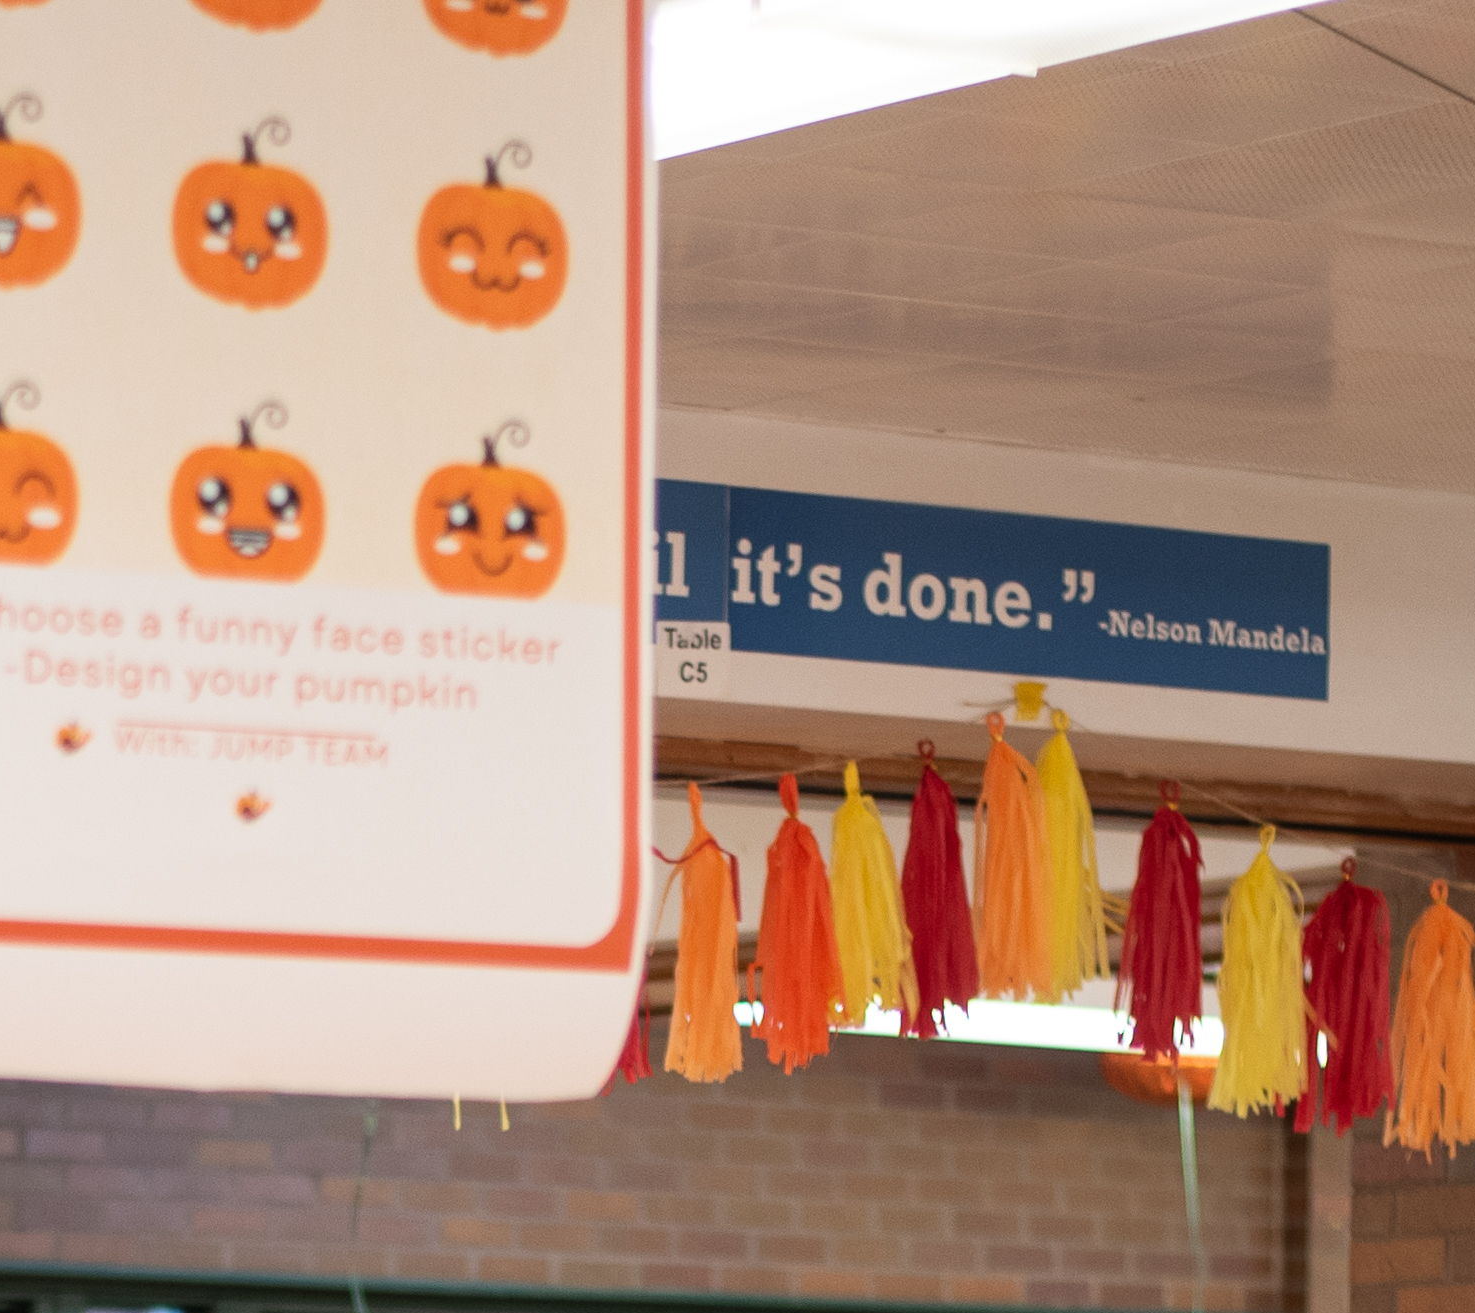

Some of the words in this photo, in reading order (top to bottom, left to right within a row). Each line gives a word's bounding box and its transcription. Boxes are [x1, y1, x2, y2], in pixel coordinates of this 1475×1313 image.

[731, 537, 843, 612] it’s
[862, 551, 1096, 631] done.”
[139, 612, 161, 640] a
[177, 604, 298, 657] funny
[313, 613, 404, 656] face
[418, 624, 561, 665] sticker
[1098, 609, 1202, 645] -Nelson
[1207, 618, 1327, 655] Mandela
[4, 648, 170, 699] -Design
[186, 667, 278, 703] your
[294, 671, 478, 715] pumpkin
[680, 661, 708, 683] C5
[207, 732, 294, 762] JUMP
[304, 737, 390, 768] TEAM
